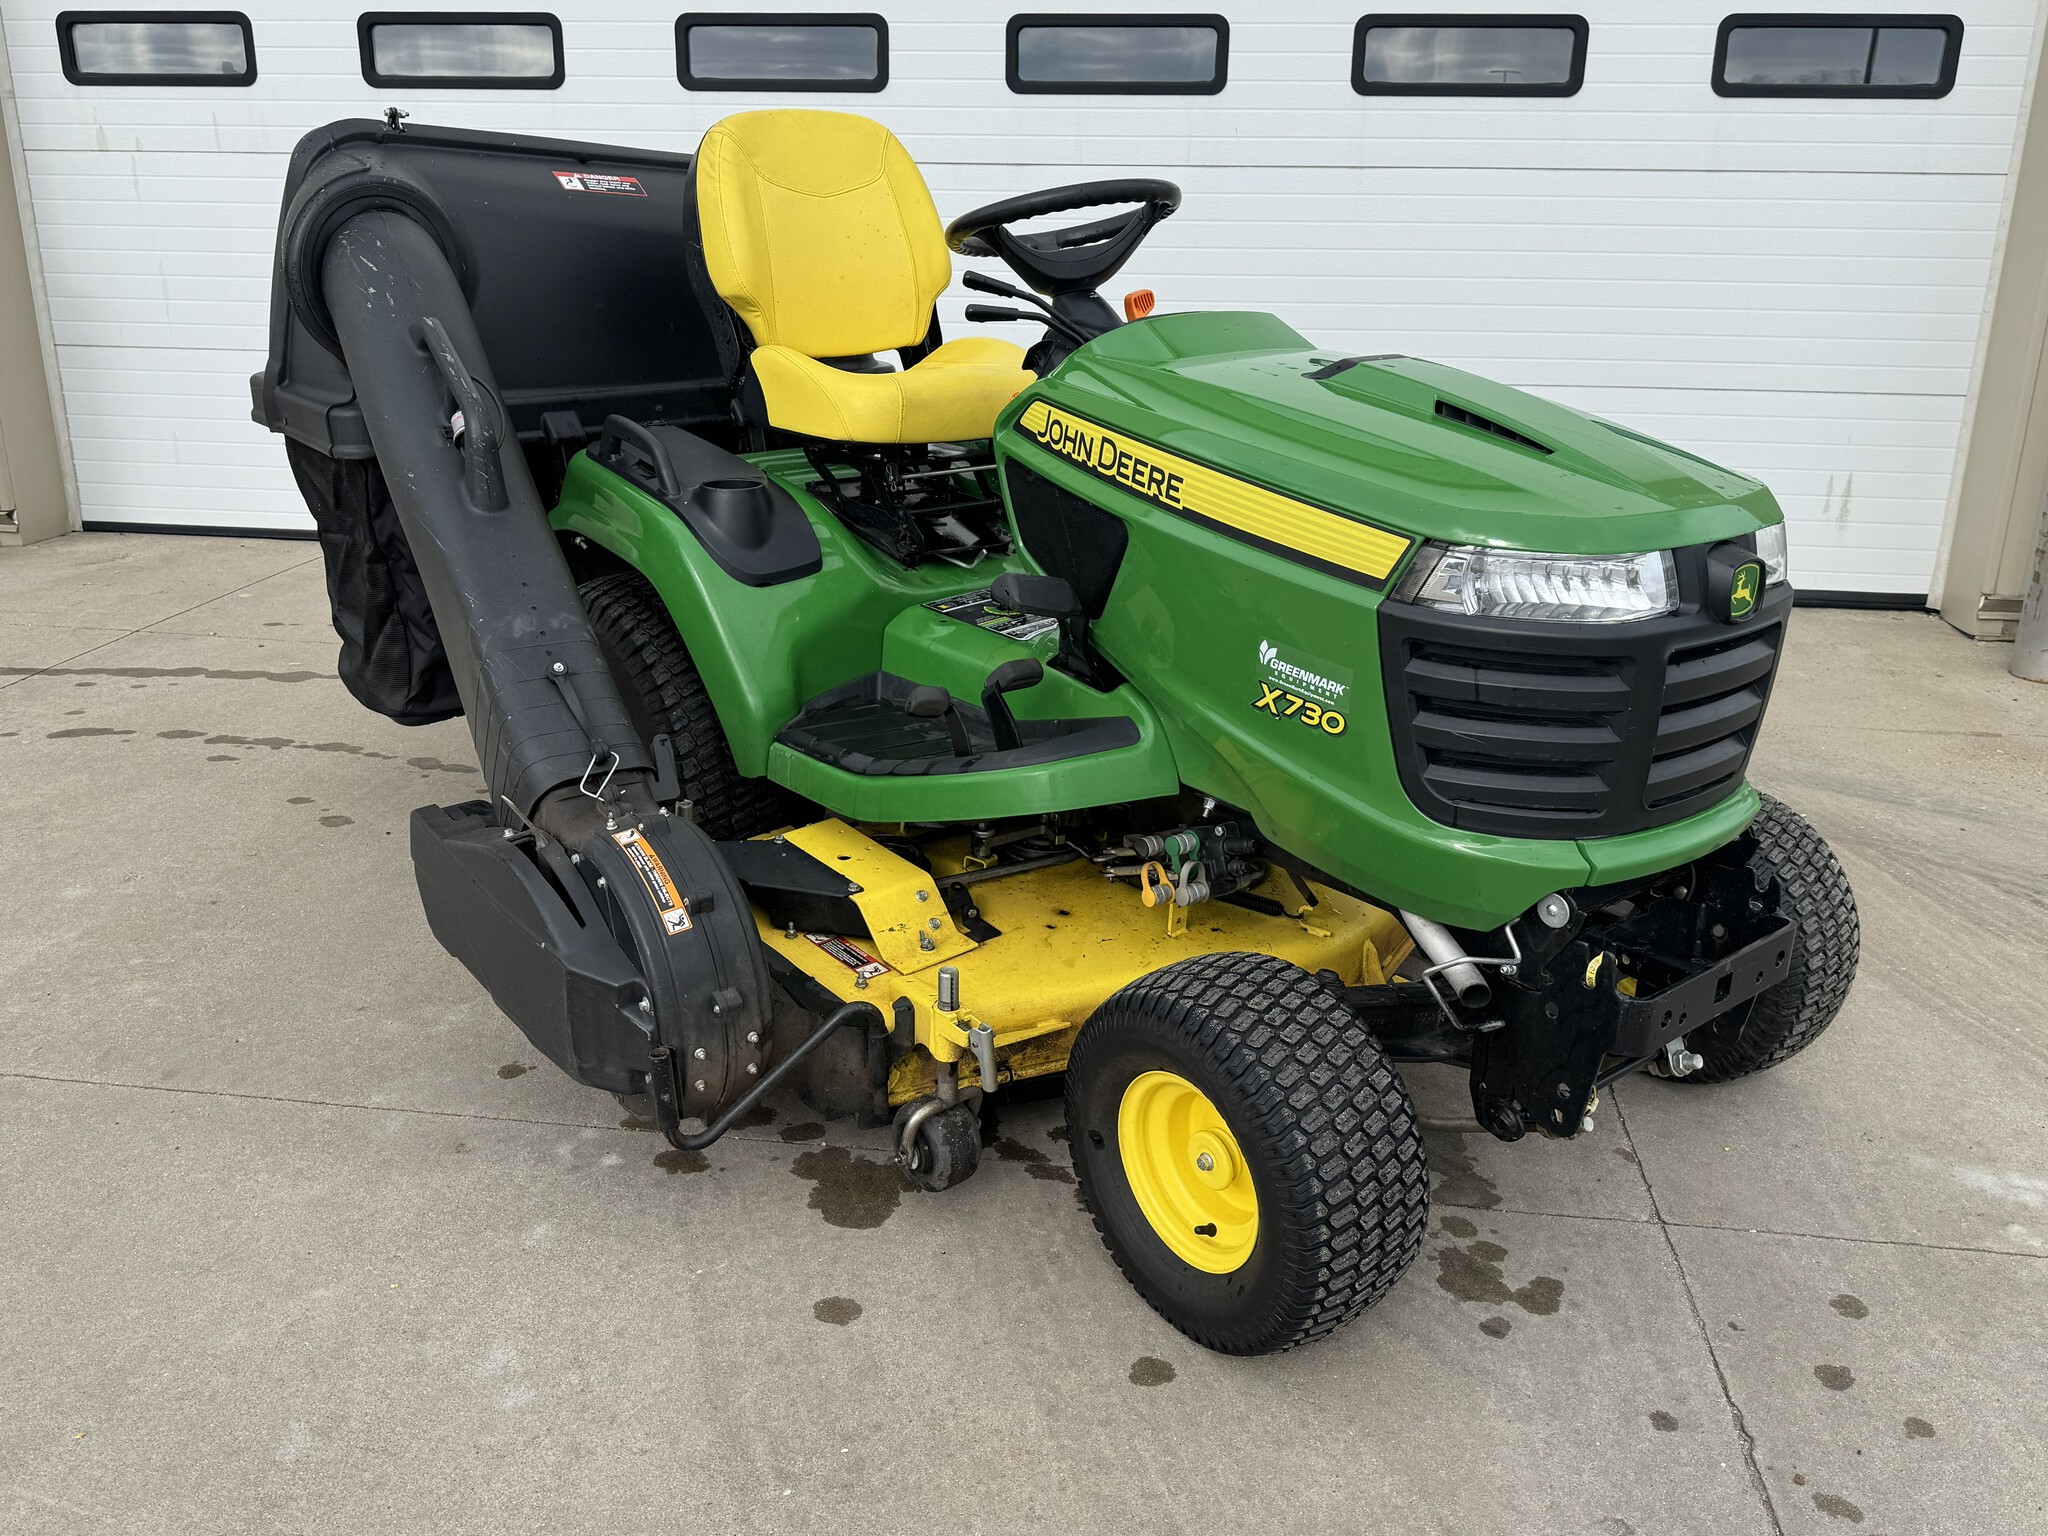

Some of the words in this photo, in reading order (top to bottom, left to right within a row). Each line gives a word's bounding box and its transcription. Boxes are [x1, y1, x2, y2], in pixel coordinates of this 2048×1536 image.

[583, 173, 620, 181] DANGER
[1037, 409, 1095, 463] JOHN
[1097, 435, 1185, 505] DEERE
[1274, 671, 1339, 700] EQUIPMENT
[1251, 680, 1348, 736] X730
[651, 855, 671, 885] WARNING
